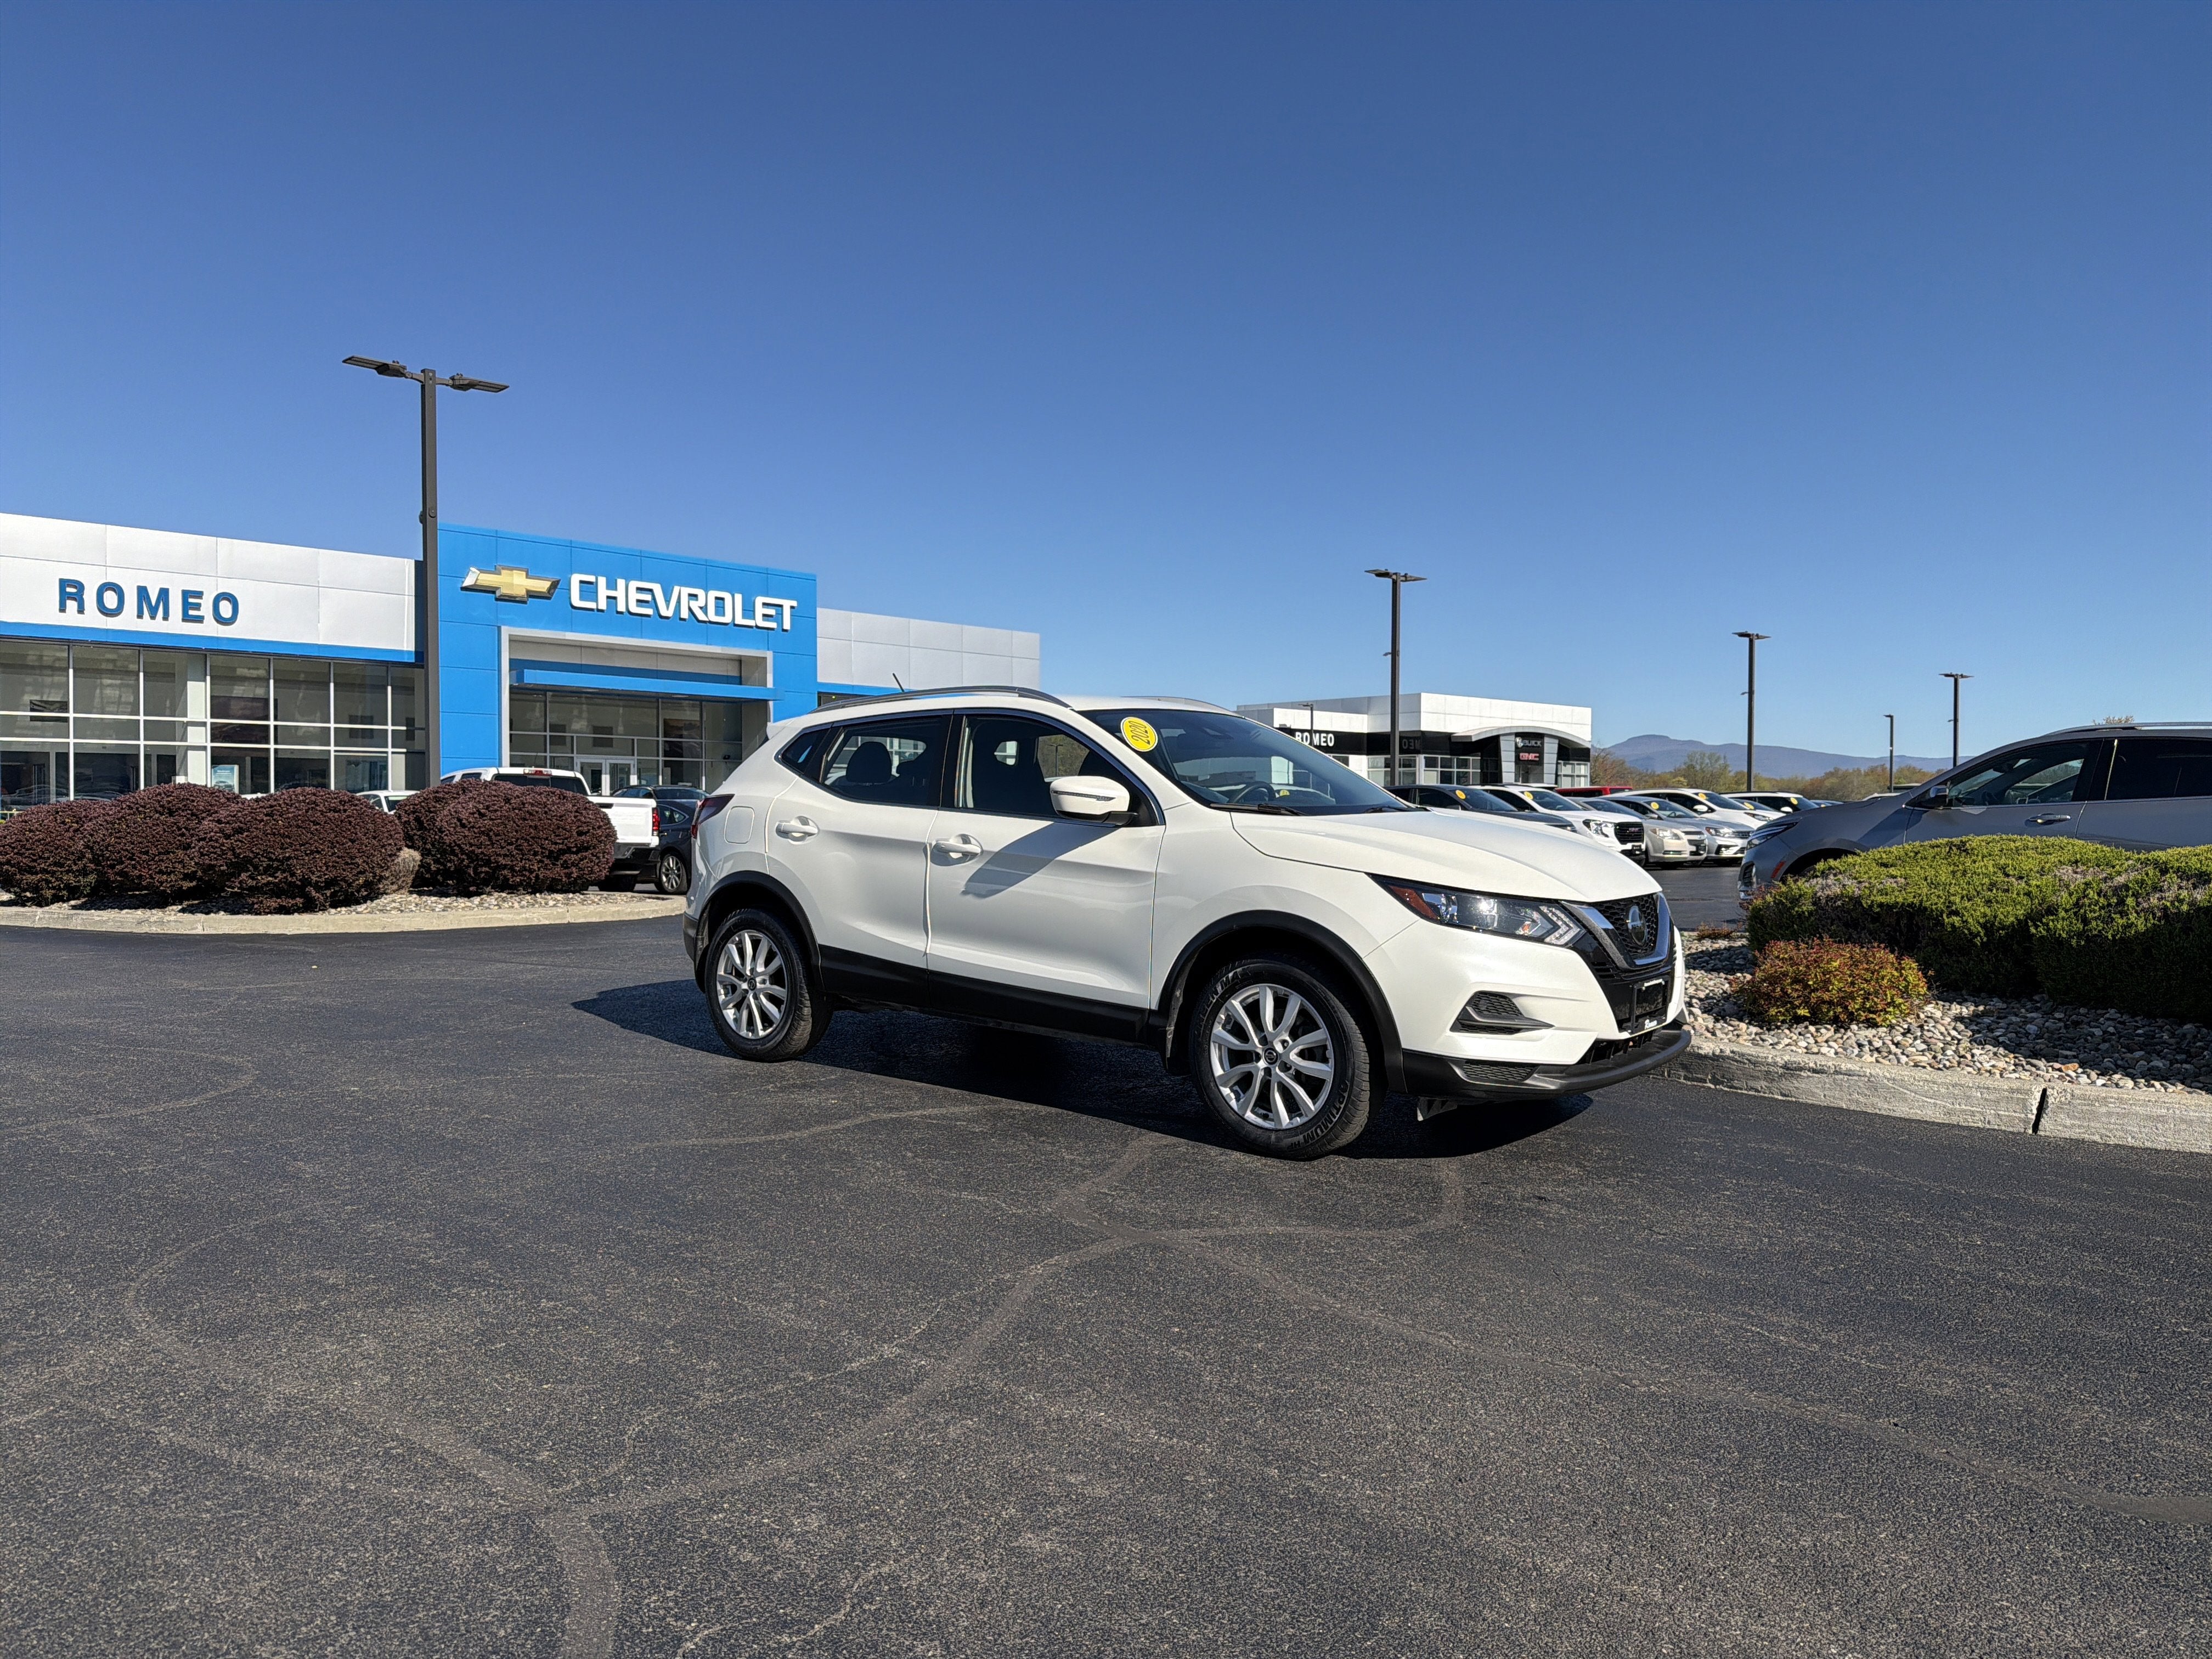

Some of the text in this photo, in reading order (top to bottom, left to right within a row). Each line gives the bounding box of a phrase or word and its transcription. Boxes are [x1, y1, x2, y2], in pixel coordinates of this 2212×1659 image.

[58, 578, 240, 626] ROMEO
[569, 573, 798, 632] CHEVROLET
[1295, 731, 1335, 747] ROMEO
[1519, 752, 1539, 761] GMC
[1302, 1080, 1349, 1146] OPTIMUM
